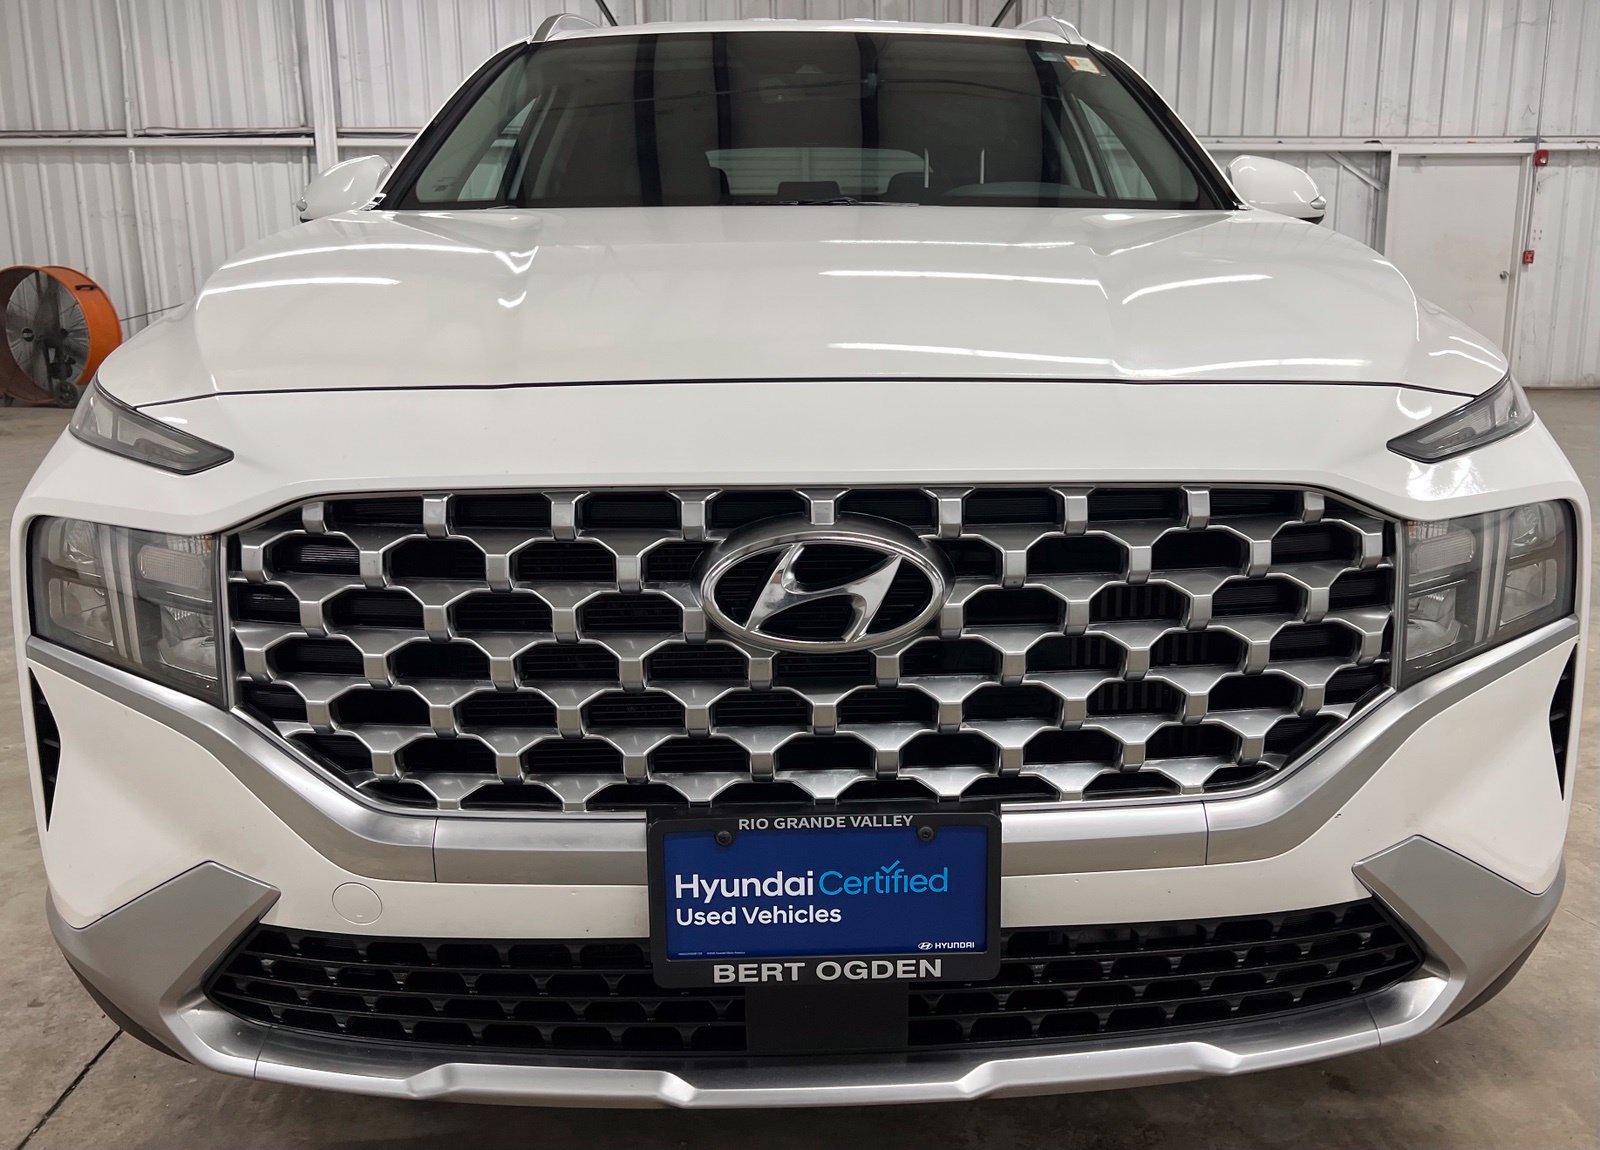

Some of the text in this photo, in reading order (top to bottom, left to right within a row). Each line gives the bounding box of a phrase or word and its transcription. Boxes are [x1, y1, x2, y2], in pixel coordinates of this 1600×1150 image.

[738, 815, 914, 831] RIO GRANDE VALLEY
[675, 860, 948, 903] Hyundai Certified
[676, 905, 842, 926] Used Vehicles
[713, 959, 942, 984] BERT OGDEN
